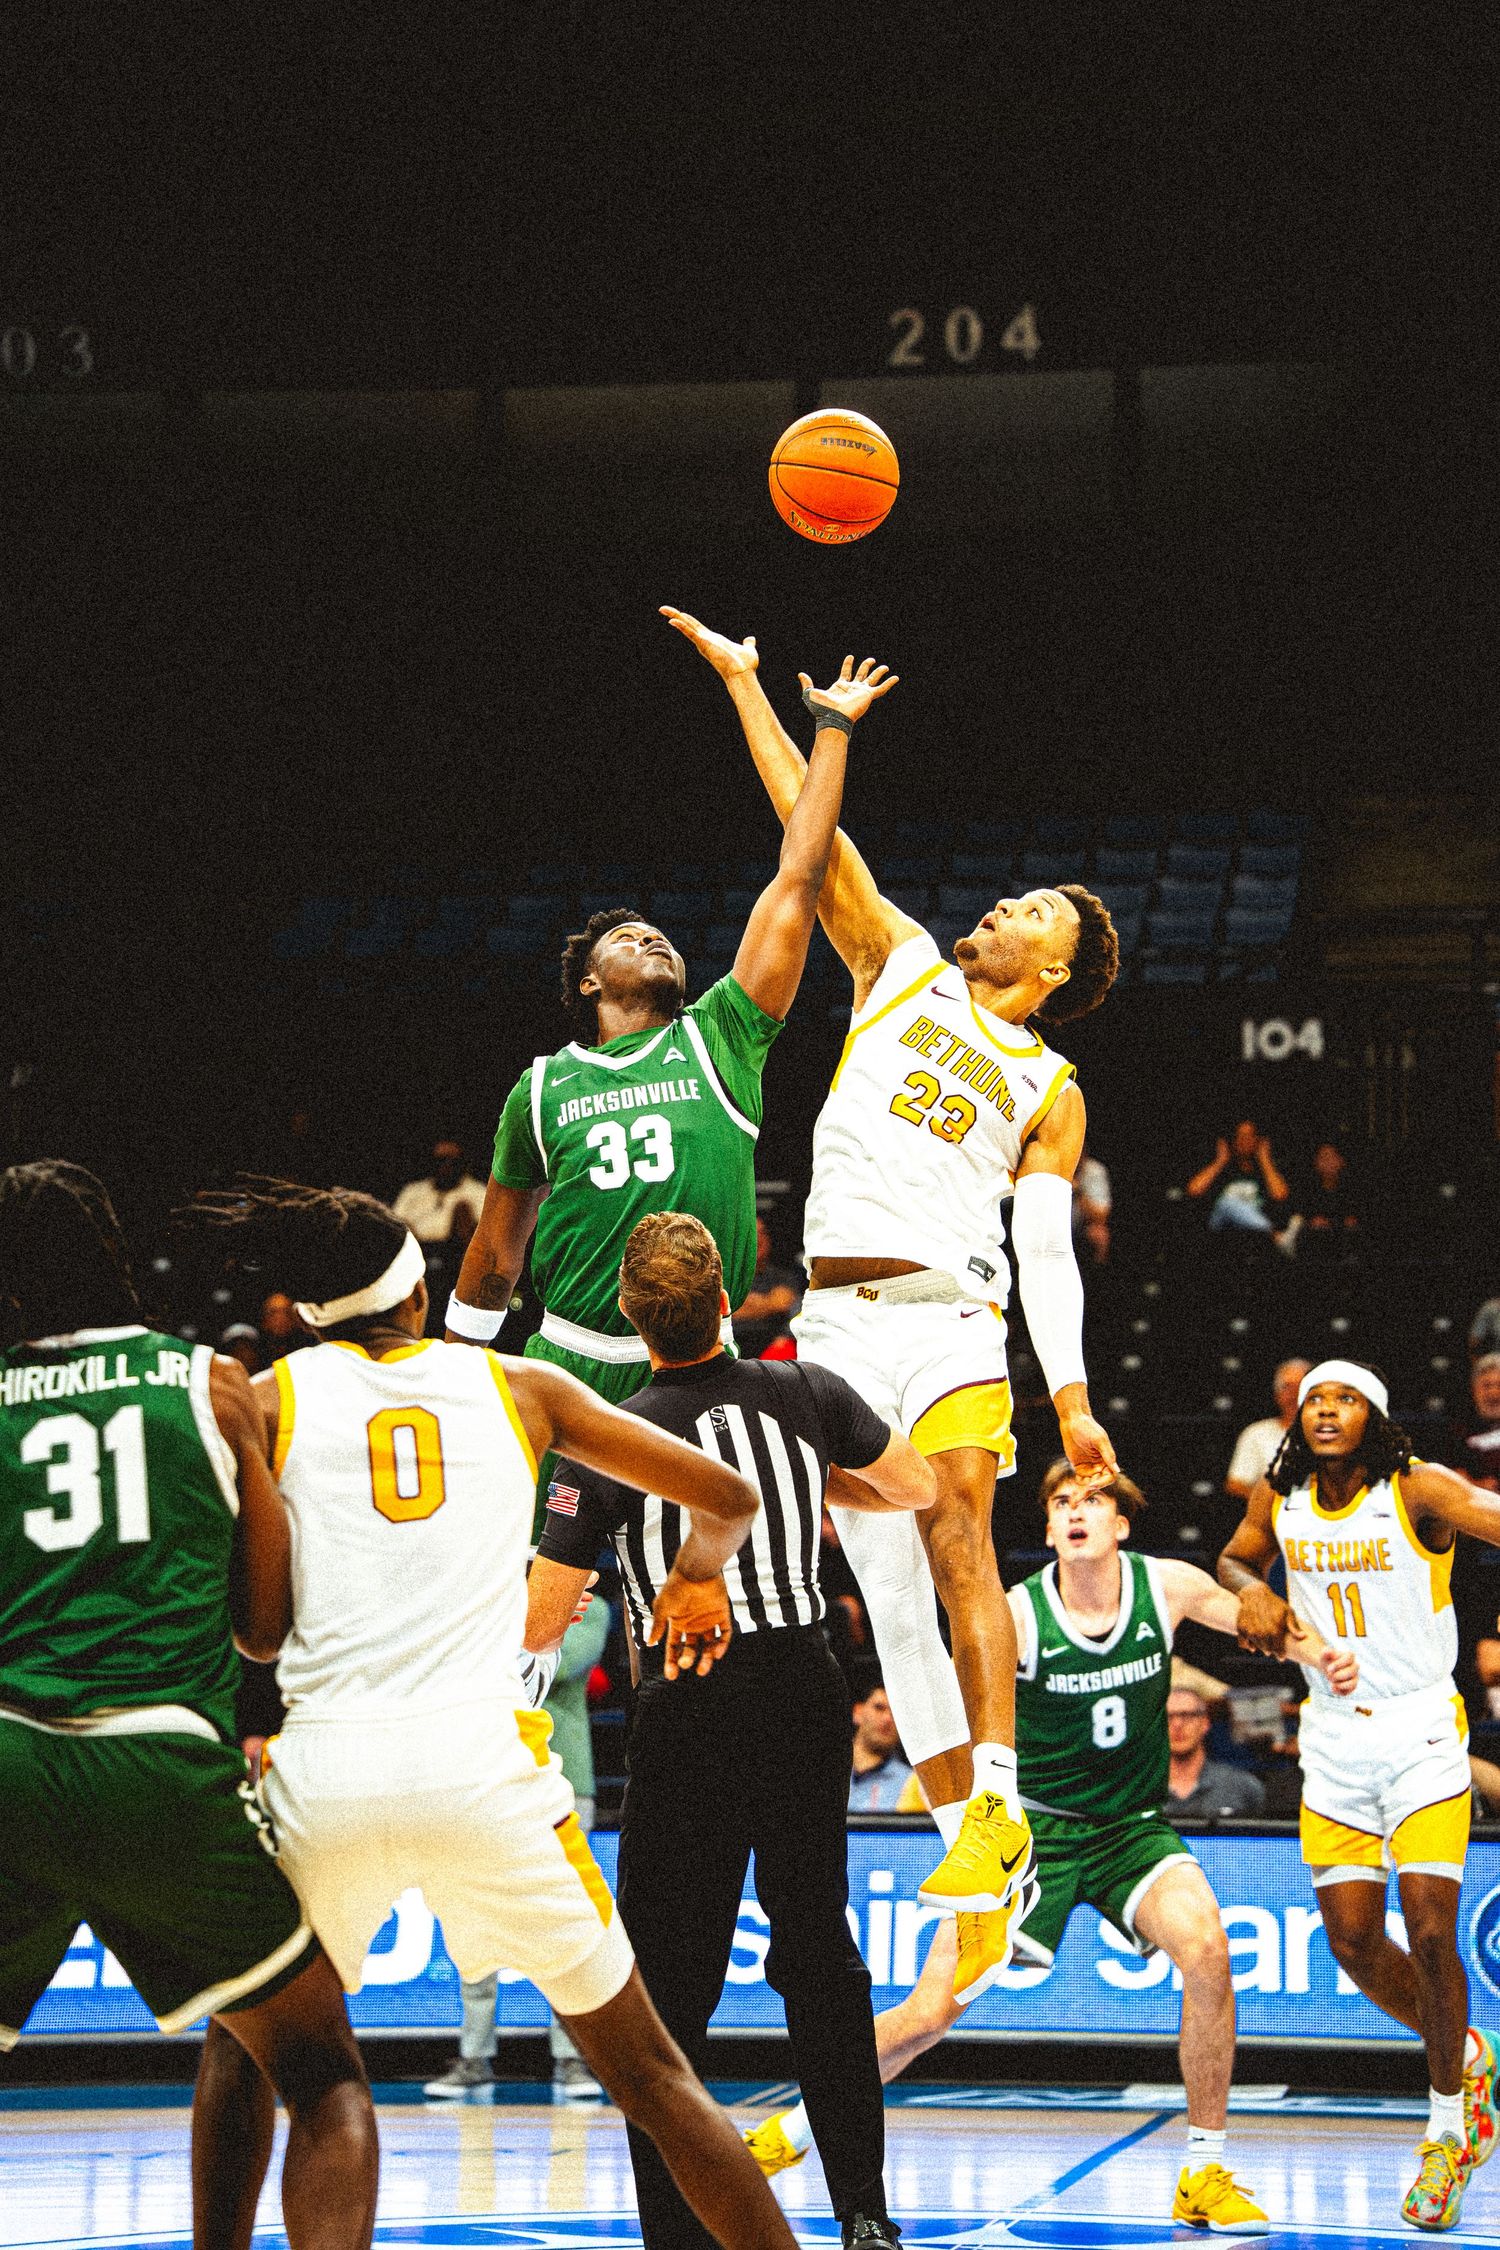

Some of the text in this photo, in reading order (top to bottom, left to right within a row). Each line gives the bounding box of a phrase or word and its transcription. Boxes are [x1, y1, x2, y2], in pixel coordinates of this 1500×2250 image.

[889, 304, 1042, 366] 204
[1240, 1017, 1324, 1062] 104
[556, 1078, 702, 1128] JACKSONVILLE
[889, 1070, 977, 1145] 23
[585, 1113, 676, 1191] 33
[856, 1286, 880, 1302] BCU
[20, 1404, 151, 1552] 31
[366, 1405, 446, 1523] 0
[1284, 1536, 1393, 1573] BETHUNE
[1326, 1582, 1367, 1637] 11
[1045, 1652, 1163, 1694] JACKSONVILLE
[1091, 1695, 1127, 1749] 8
